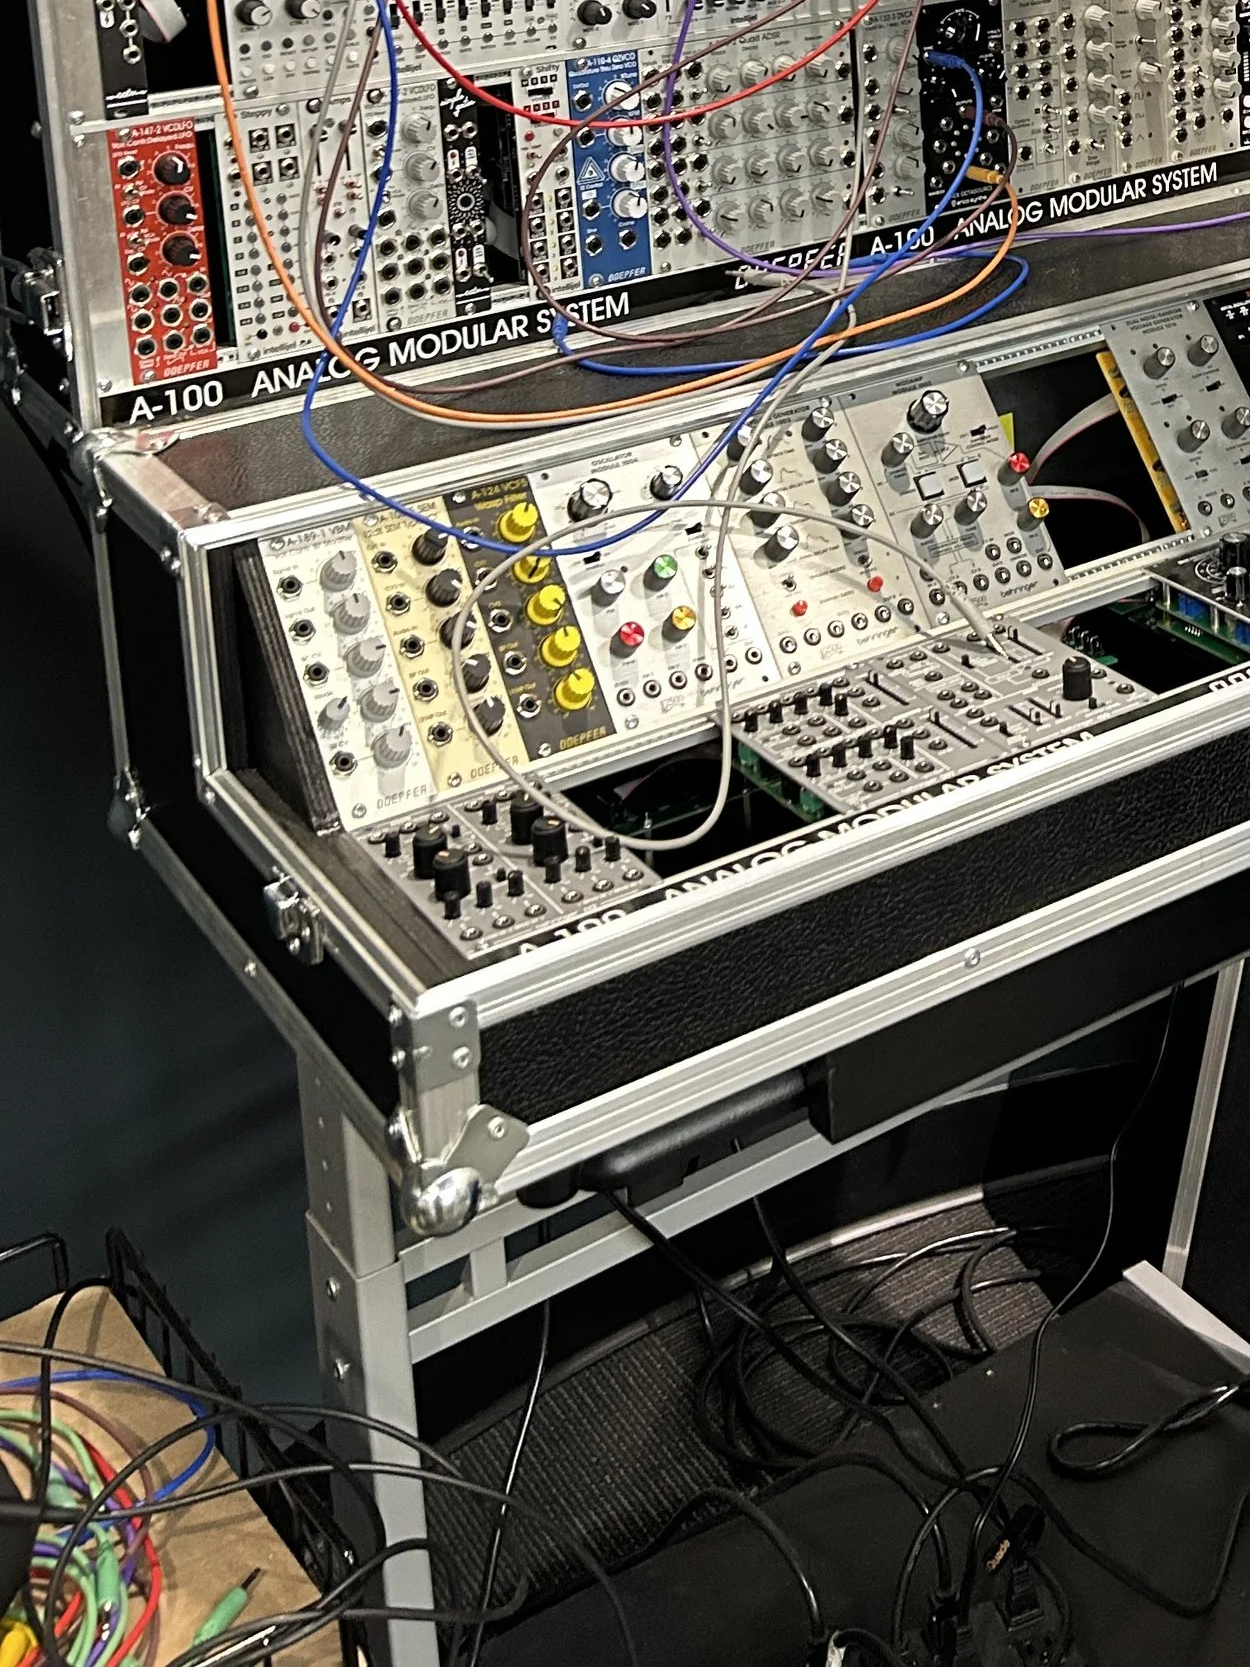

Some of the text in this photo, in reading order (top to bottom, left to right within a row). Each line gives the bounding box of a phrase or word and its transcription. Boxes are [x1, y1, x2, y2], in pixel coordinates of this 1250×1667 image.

[536, 64, 560, 75] Shifty
[240, 108, 273, 122] Steppy
[132, 125, 162, 136] A-147-2
[869, 161, 1218, 257] A-100 ANALOG MODULAR SYSTEM
[740, 240, 775, 253] DOEPFER
[607, 267, 646, 283] DOEPFER
[407, 309, 449, 325] DOEPFER
[129, 379, 225, 426] A-100
[251, 346, 379, 400] ANALOG
[389, 313, 530, 368] MODULAR
[163, 357, 210, 377] DOEPFER
[590, 451, 633, 467] OSCILLATOR
[505, 491, 528, 505] Filter
[559, 725, 608, 751] DOEPFER
[470, 753, 520, 780] DOEPR
[376, 784, 428, 811] DOEPFER
